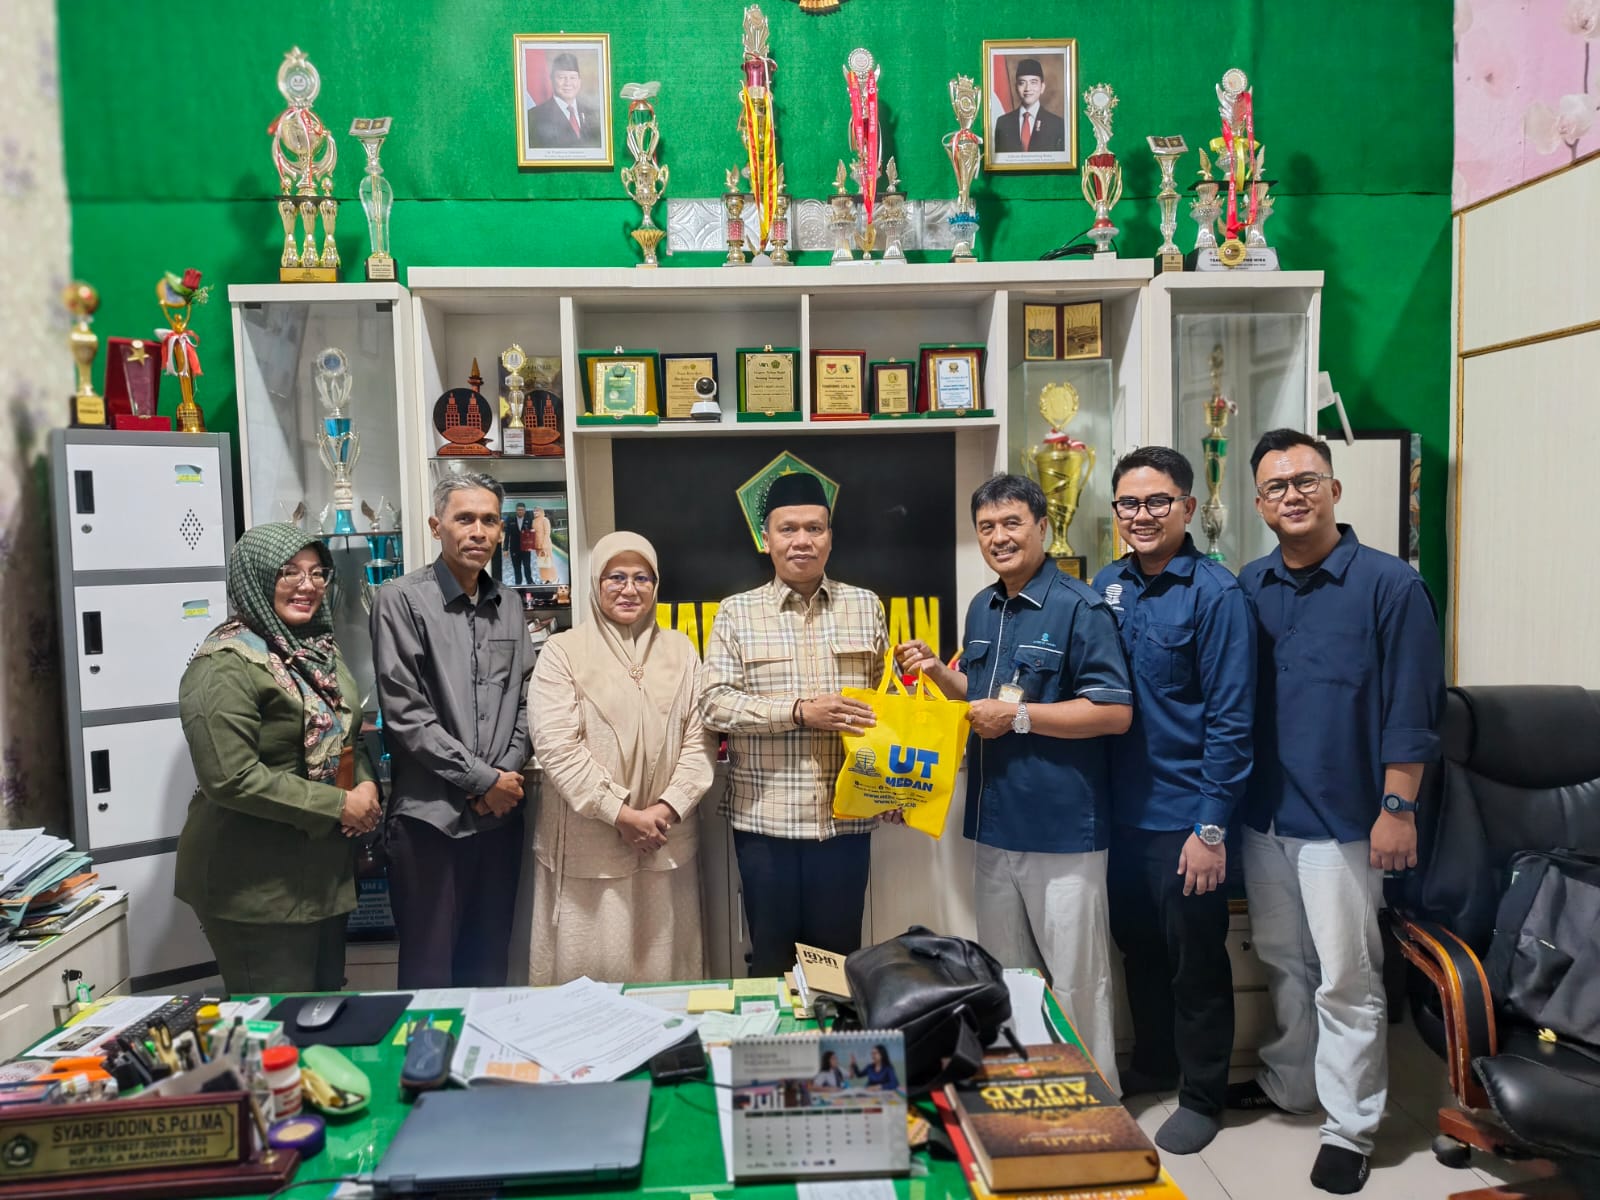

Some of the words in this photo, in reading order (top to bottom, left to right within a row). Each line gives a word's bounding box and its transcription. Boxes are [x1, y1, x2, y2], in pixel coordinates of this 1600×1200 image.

[888, 744, 939, 779] UT
[885, 776, 934, 793] MEDAN
[980, 1081, 1087, 1100] AULAD
